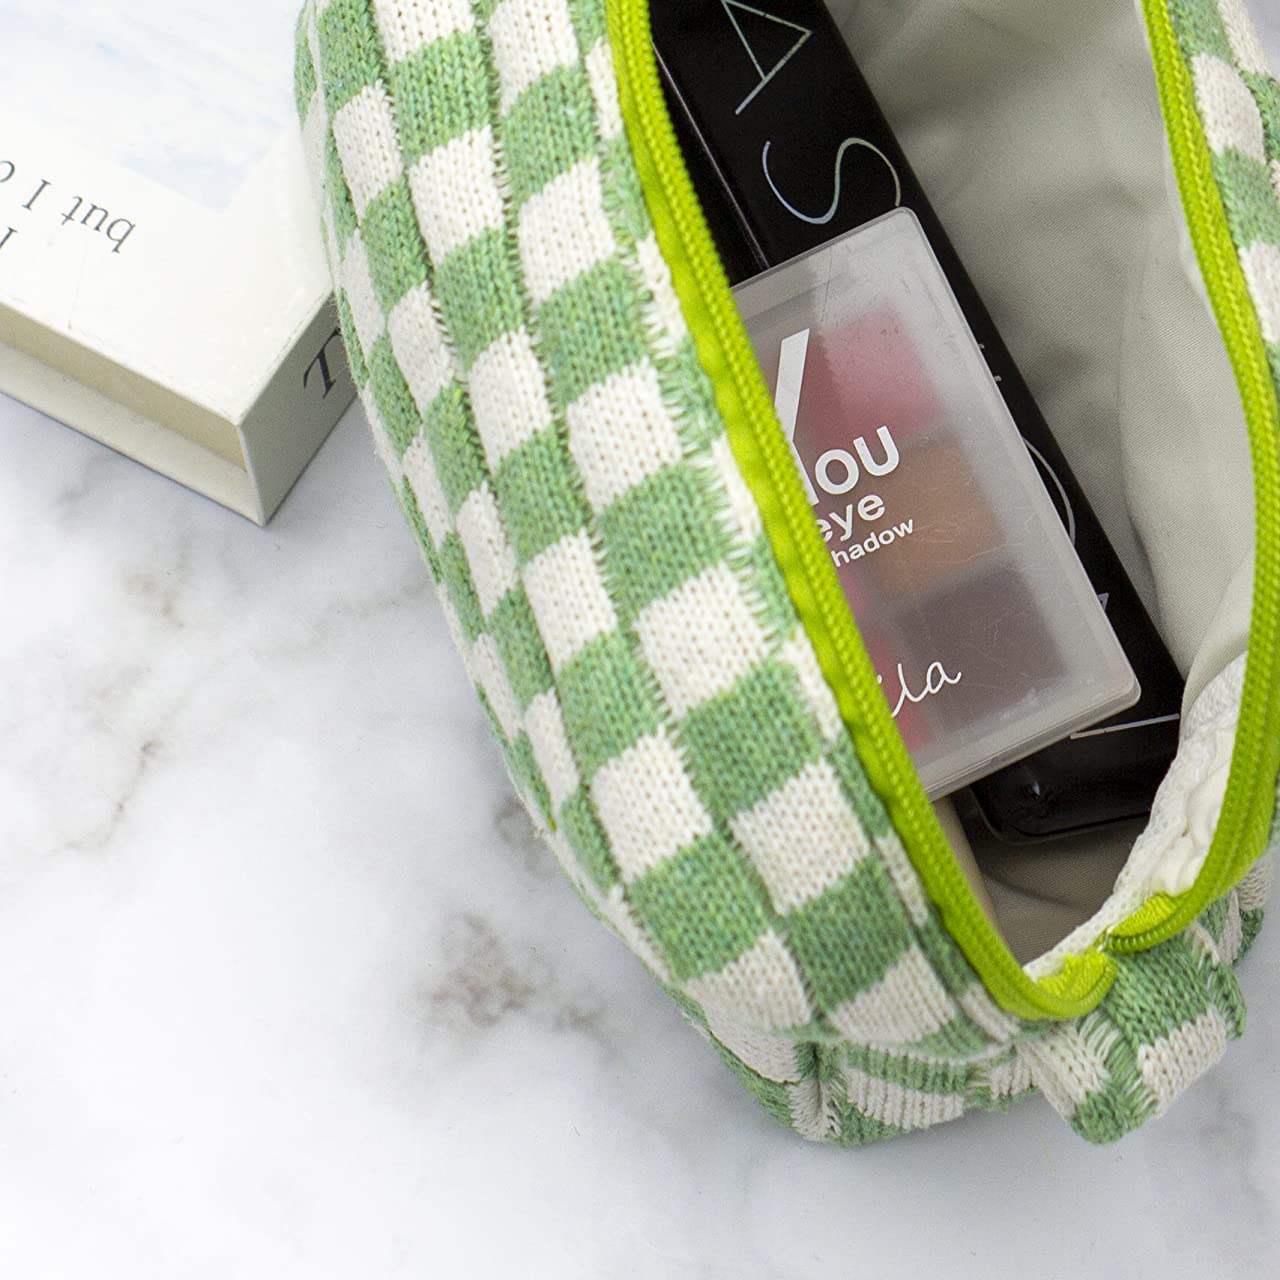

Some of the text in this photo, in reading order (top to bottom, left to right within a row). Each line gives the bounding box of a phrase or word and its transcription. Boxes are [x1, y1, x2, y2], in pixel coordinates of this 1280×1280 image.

[22, 179, 51, 211] I
[61, 196, 136, 254] but
[828, 518, 914, 568] hadow
